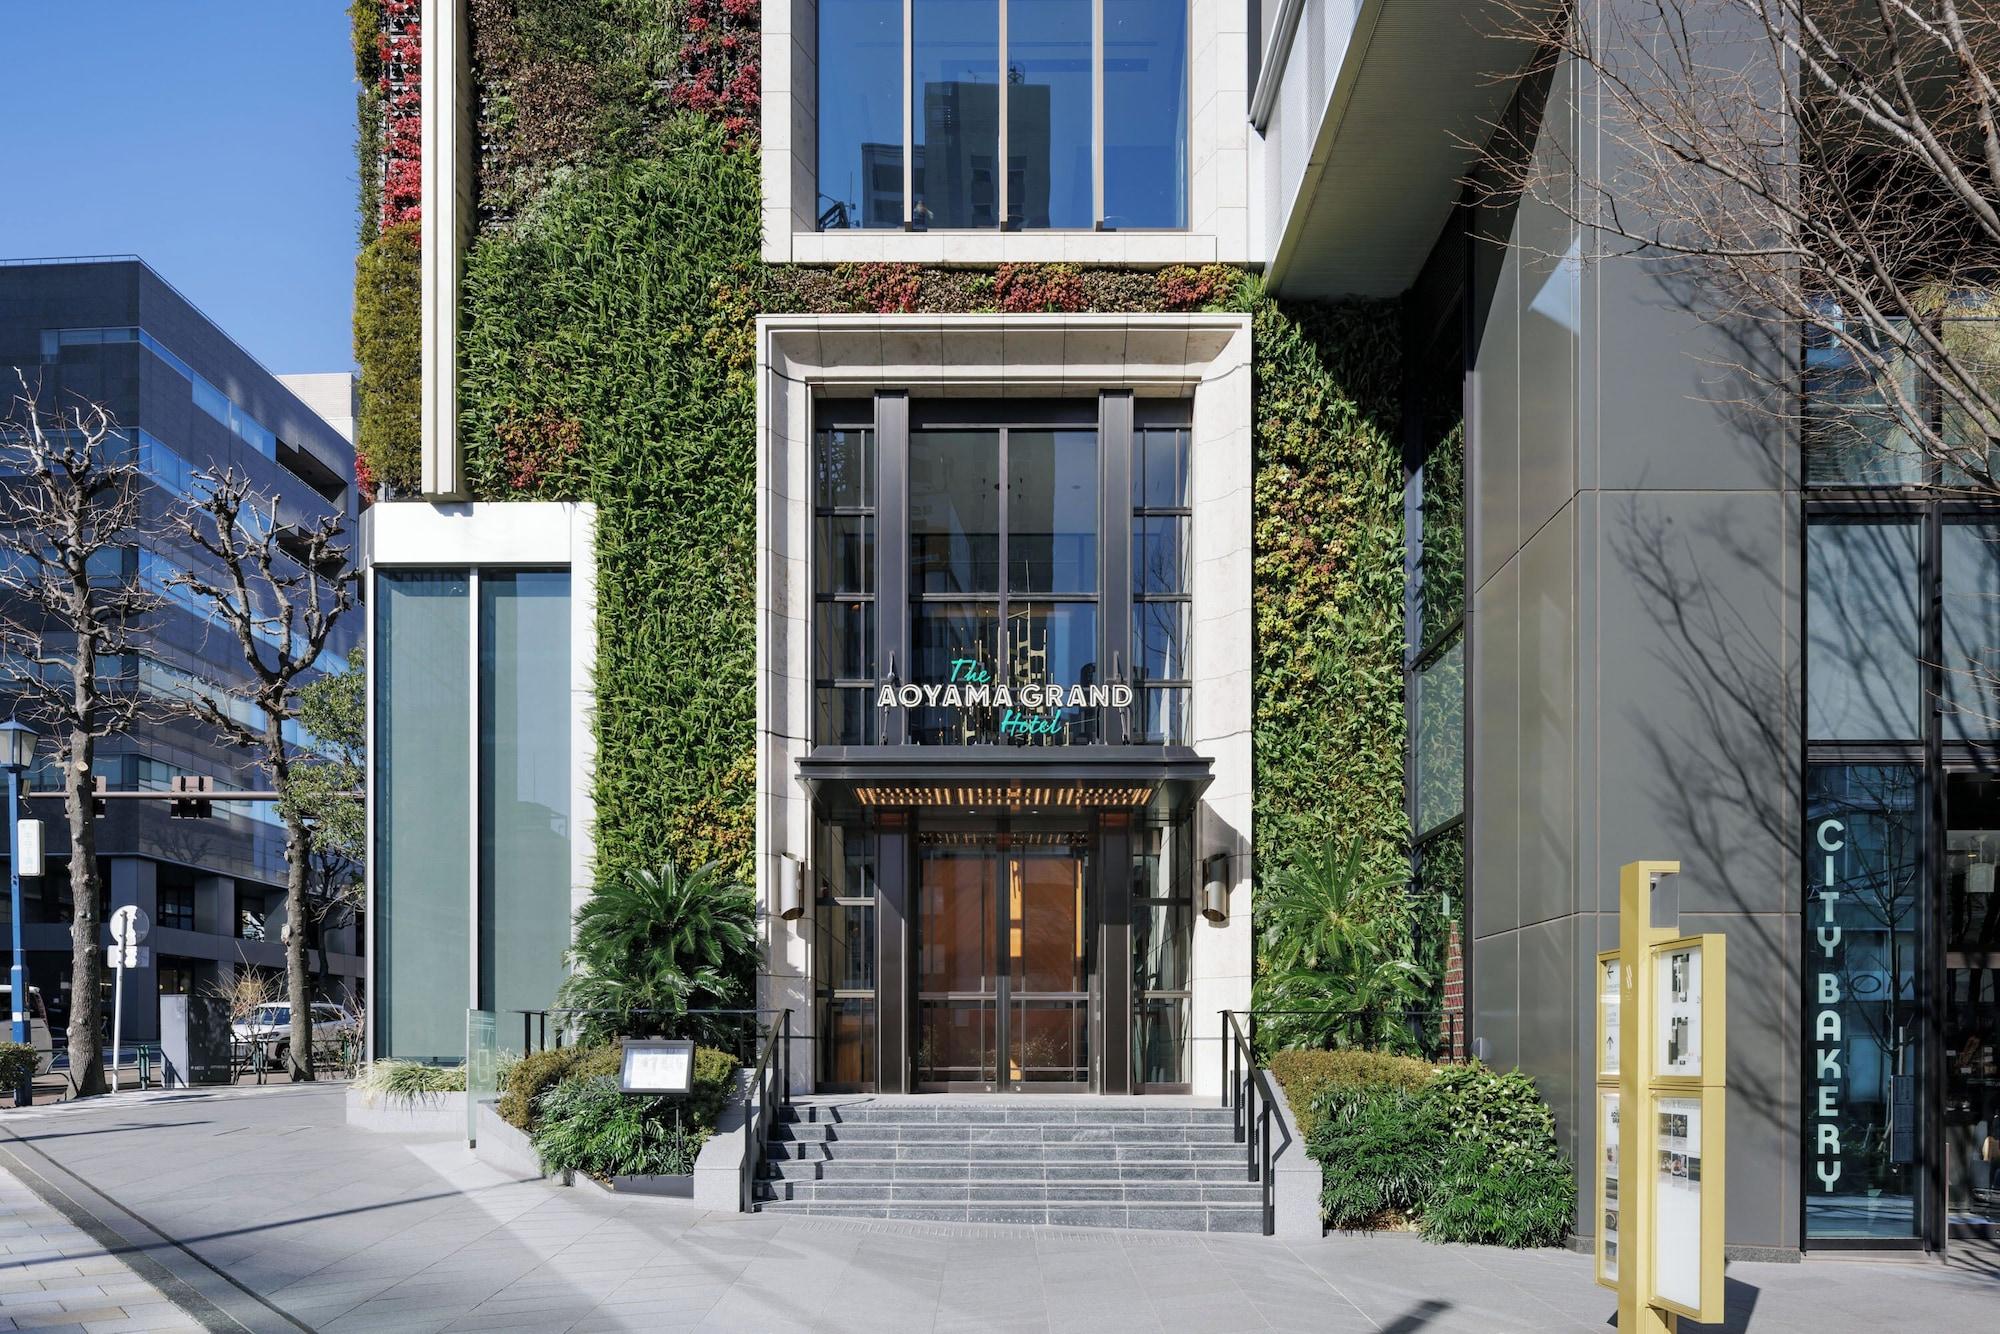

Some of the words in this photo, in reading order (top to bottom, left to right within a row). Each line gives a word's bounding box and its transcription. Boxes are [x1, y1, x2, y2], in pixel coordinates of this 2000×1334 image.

[951, 658, 991, 683] The
[877, 685, 1013, 707] AOYAMA
[1019, 684, 1133, 707] GRAND
[1000, 709, 1065, 736] Hotel
[1816, 819, 1844, 958] CITY
[1816, 973, 1842, 1192] BAKERY
